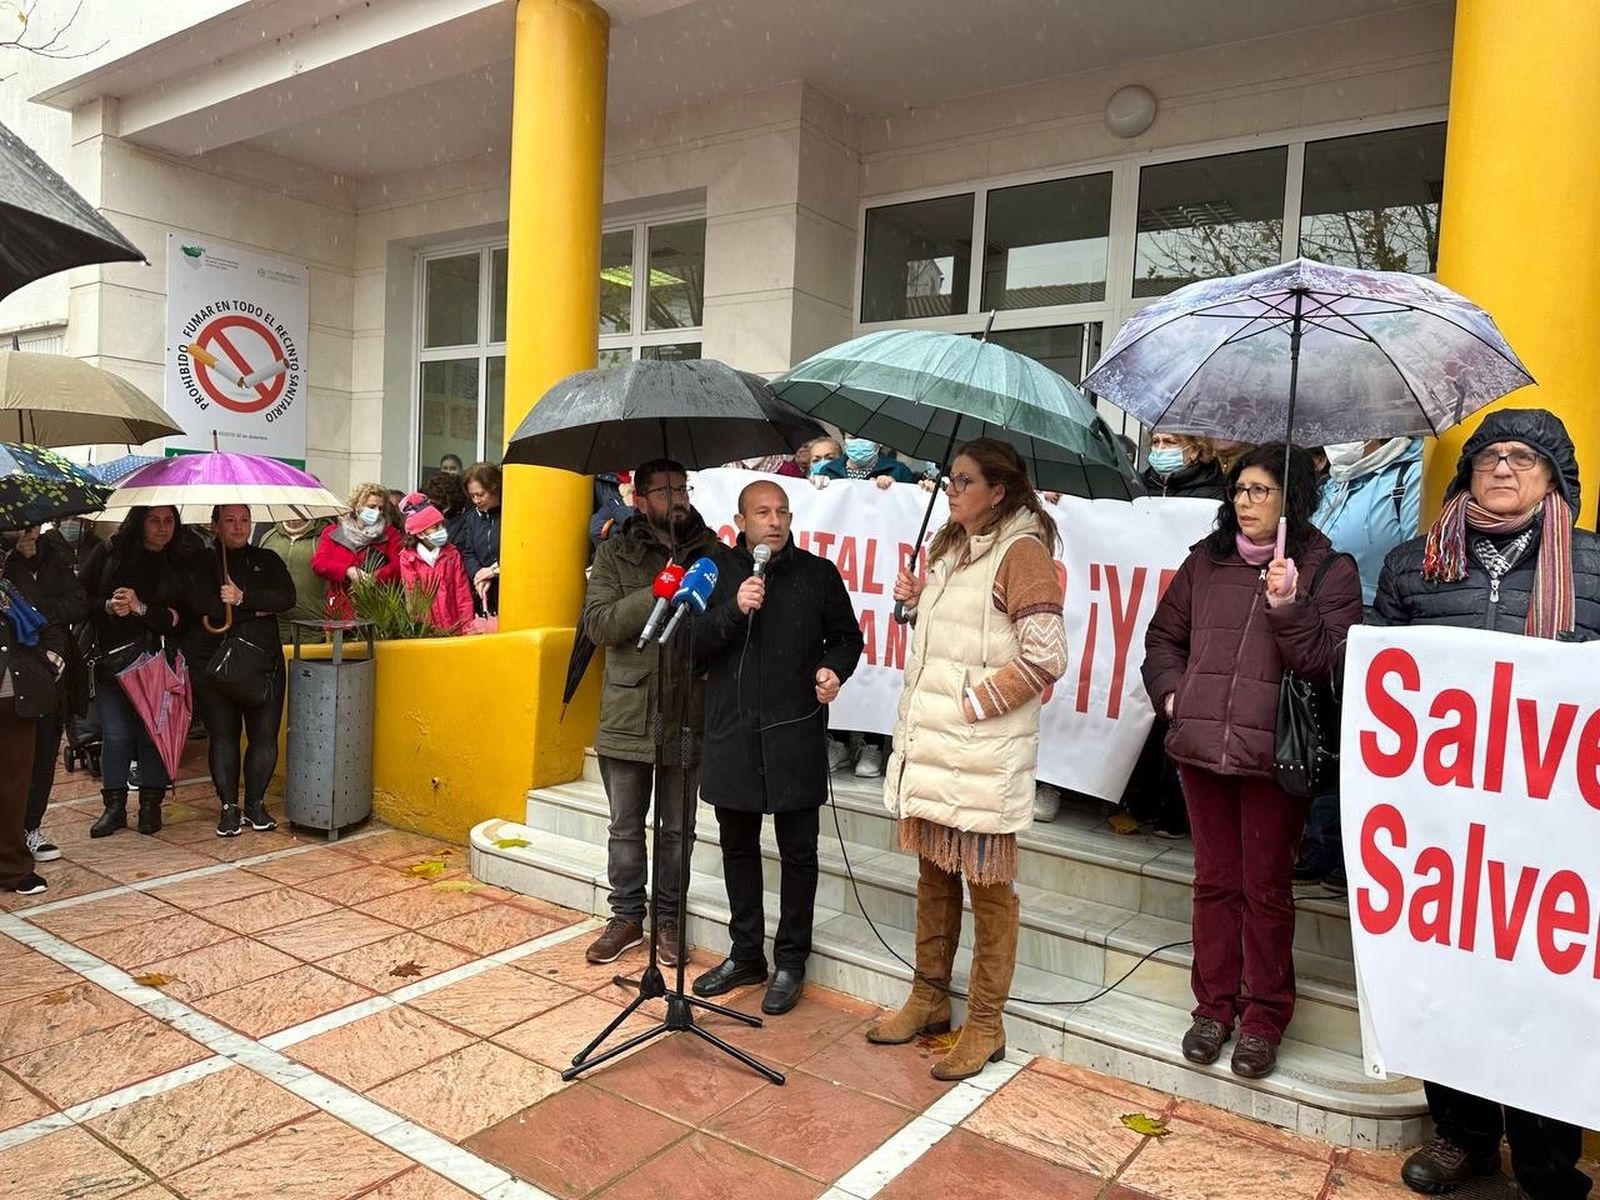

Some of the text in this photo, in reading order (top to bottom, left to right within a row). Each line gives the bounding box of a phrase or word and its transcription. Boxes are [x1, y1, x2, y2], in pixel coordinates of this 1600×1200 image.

[178, 300, 300, 423] PROHIBIDO FUMAR EN TODO EL RECINTO SANITARIO
[1076, 563, 1178, 720] ¡Y
[1357, 804, 1600, 980] Salve
